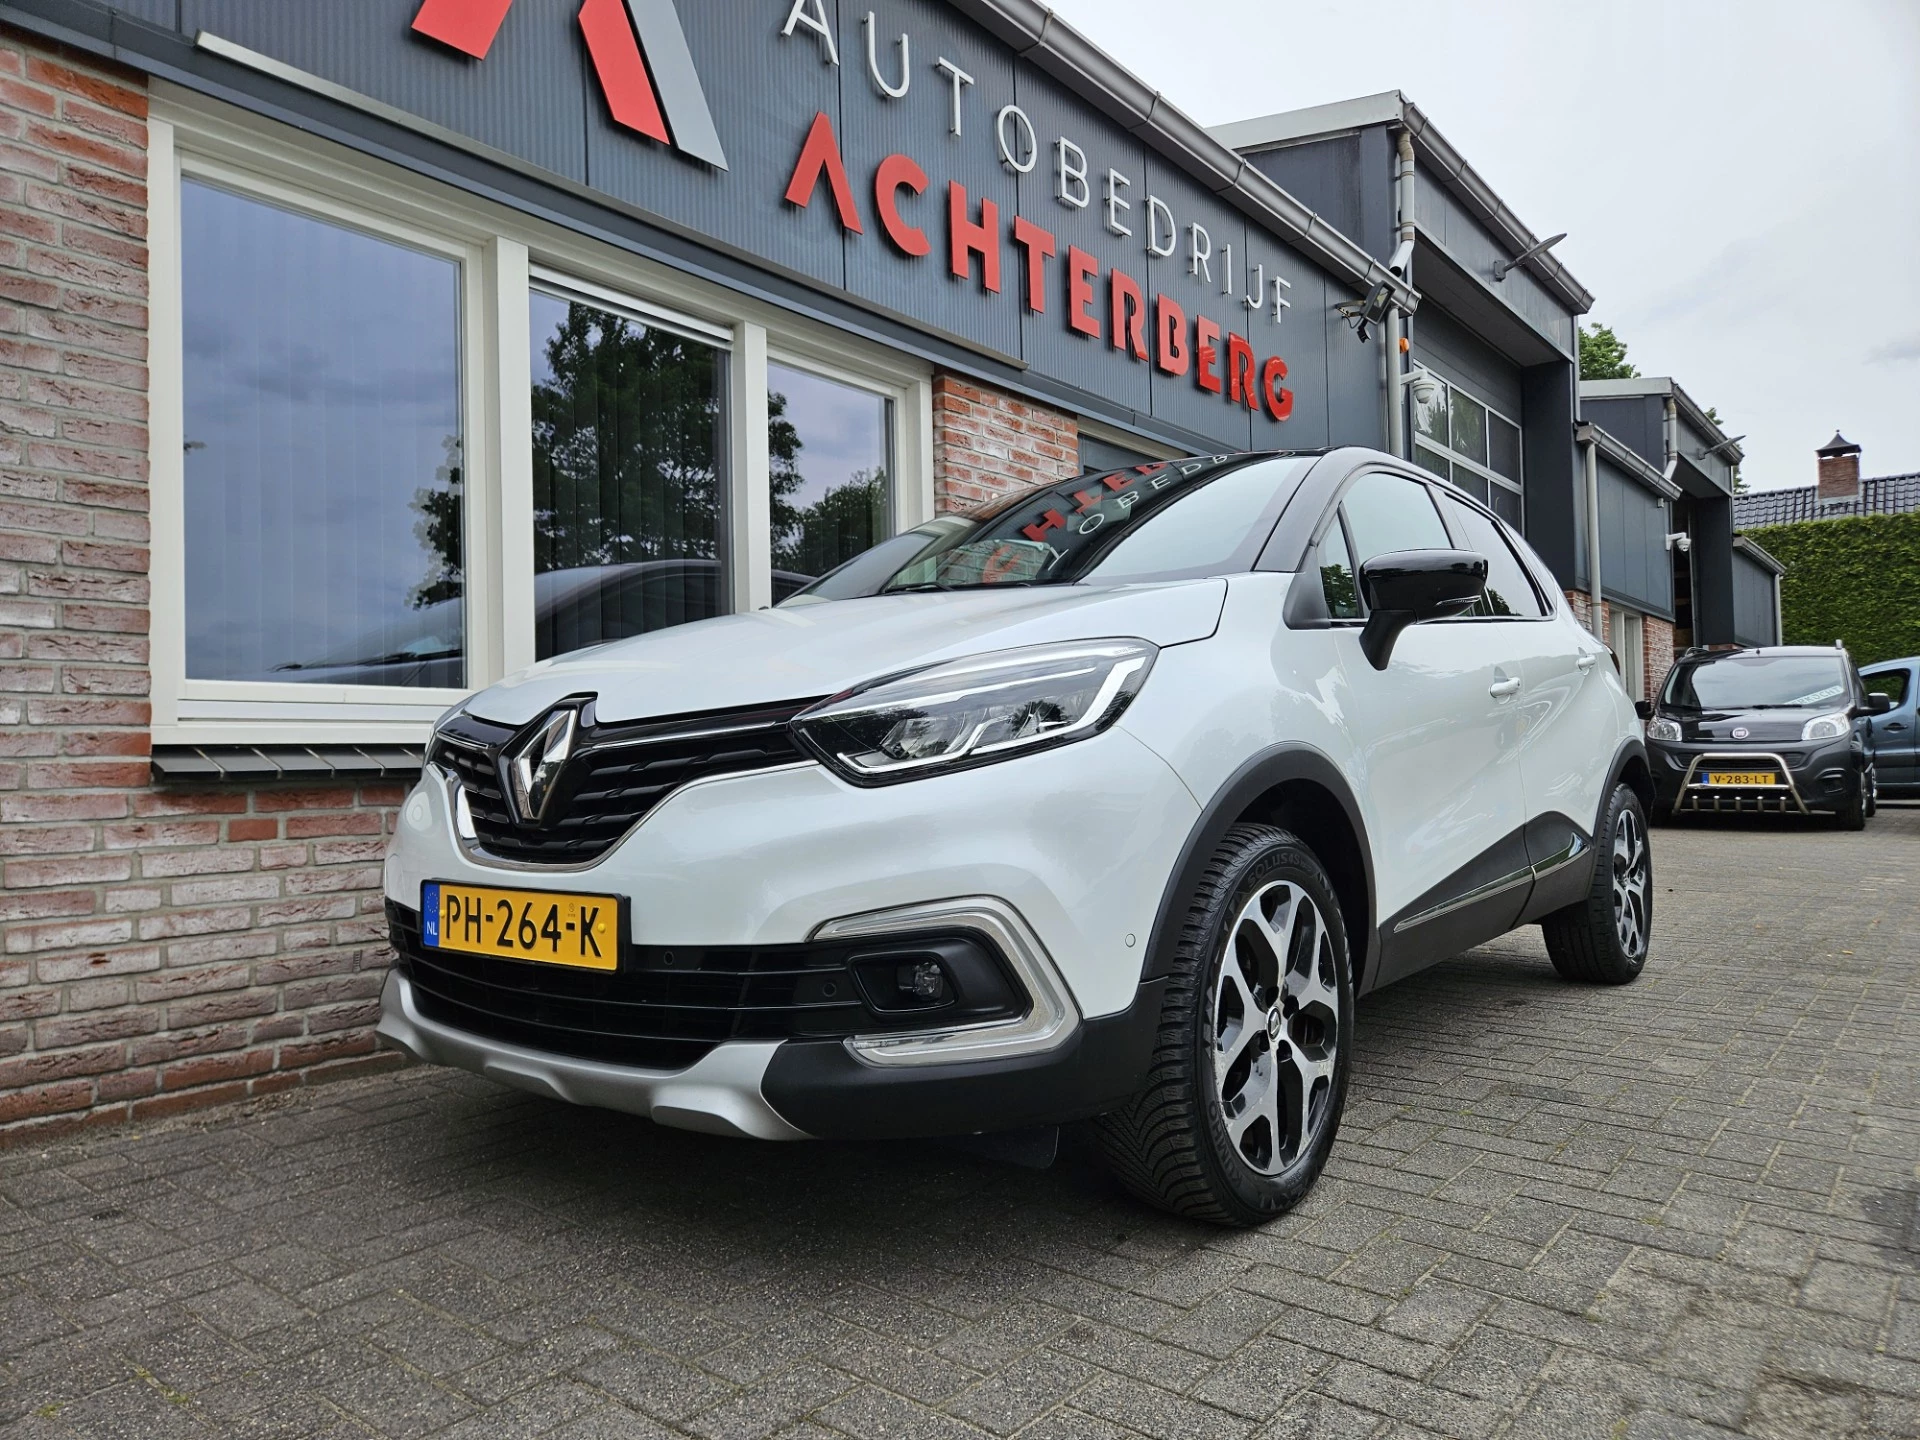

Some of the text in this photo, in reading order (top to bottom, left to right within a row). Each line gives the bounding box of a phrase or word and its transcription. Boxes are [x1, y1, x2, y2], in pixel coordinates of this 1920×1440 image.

[781, 0, 1292, 324] AUTOBEDRIJF
[785, 111, 1294, 422] ACHTERBERG
[1713, 775, 1769, 785] V-283-LT
[426, 920, 438, 936] NL
[446, 894, 602, 958] PH-264-K
